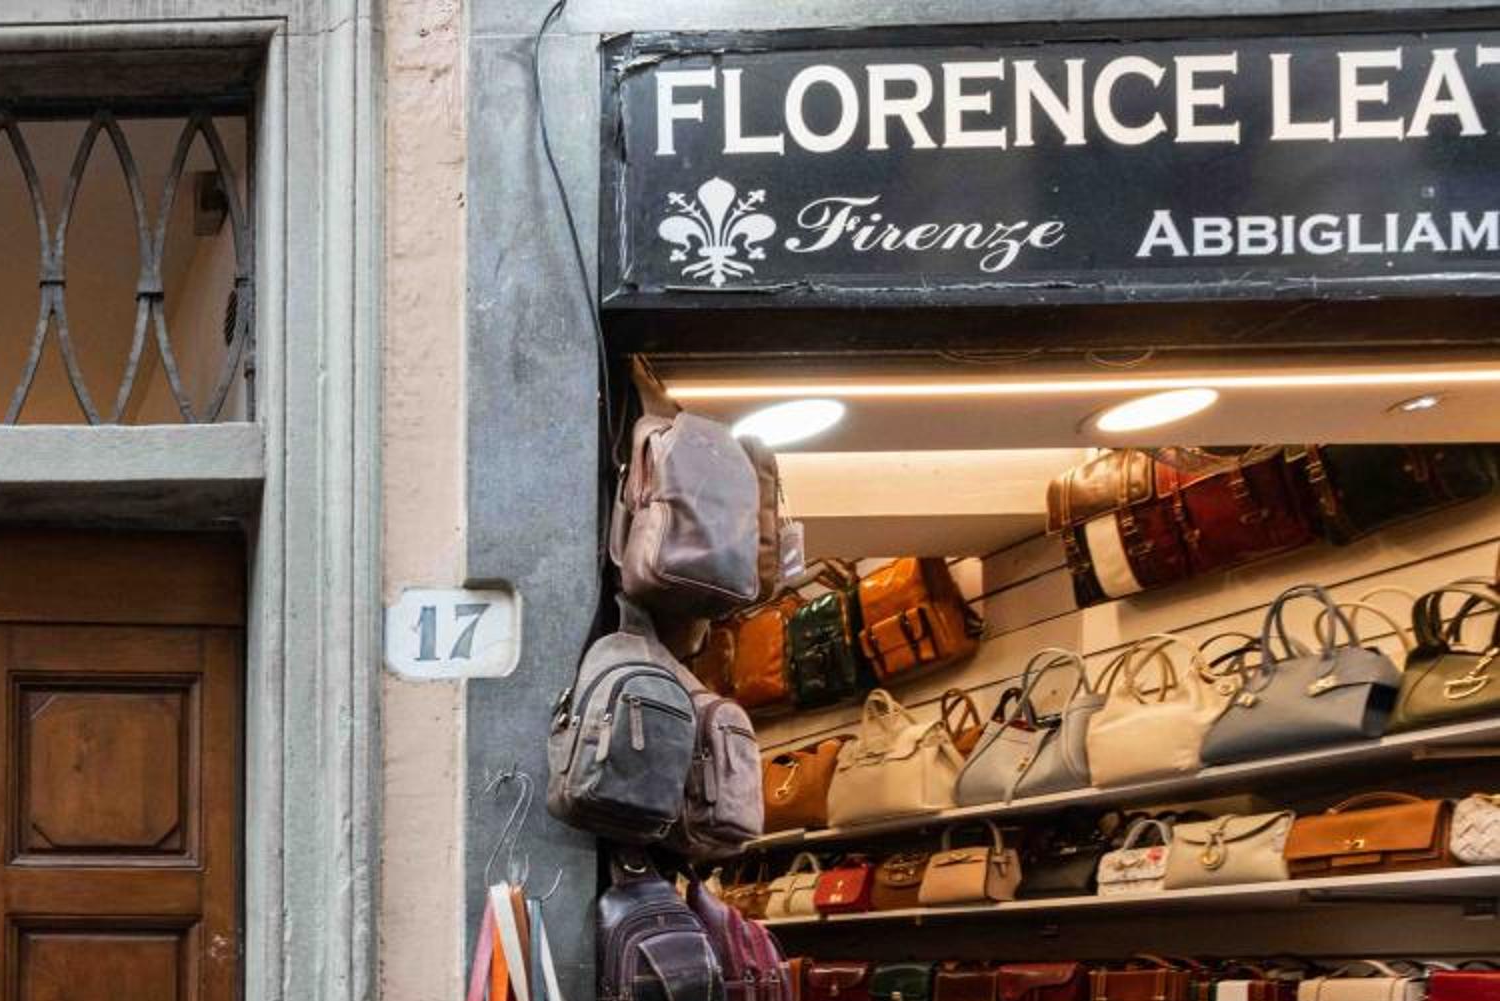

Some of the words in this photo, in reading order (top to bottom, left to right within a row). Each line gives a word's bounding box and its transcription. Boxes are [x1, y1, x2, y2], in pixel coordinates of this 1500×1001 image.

[655, 51, 1240, 155] FLORENCE
[784, 194, 1065, 273] Firenze
[410, 603, 492, 661] 17
